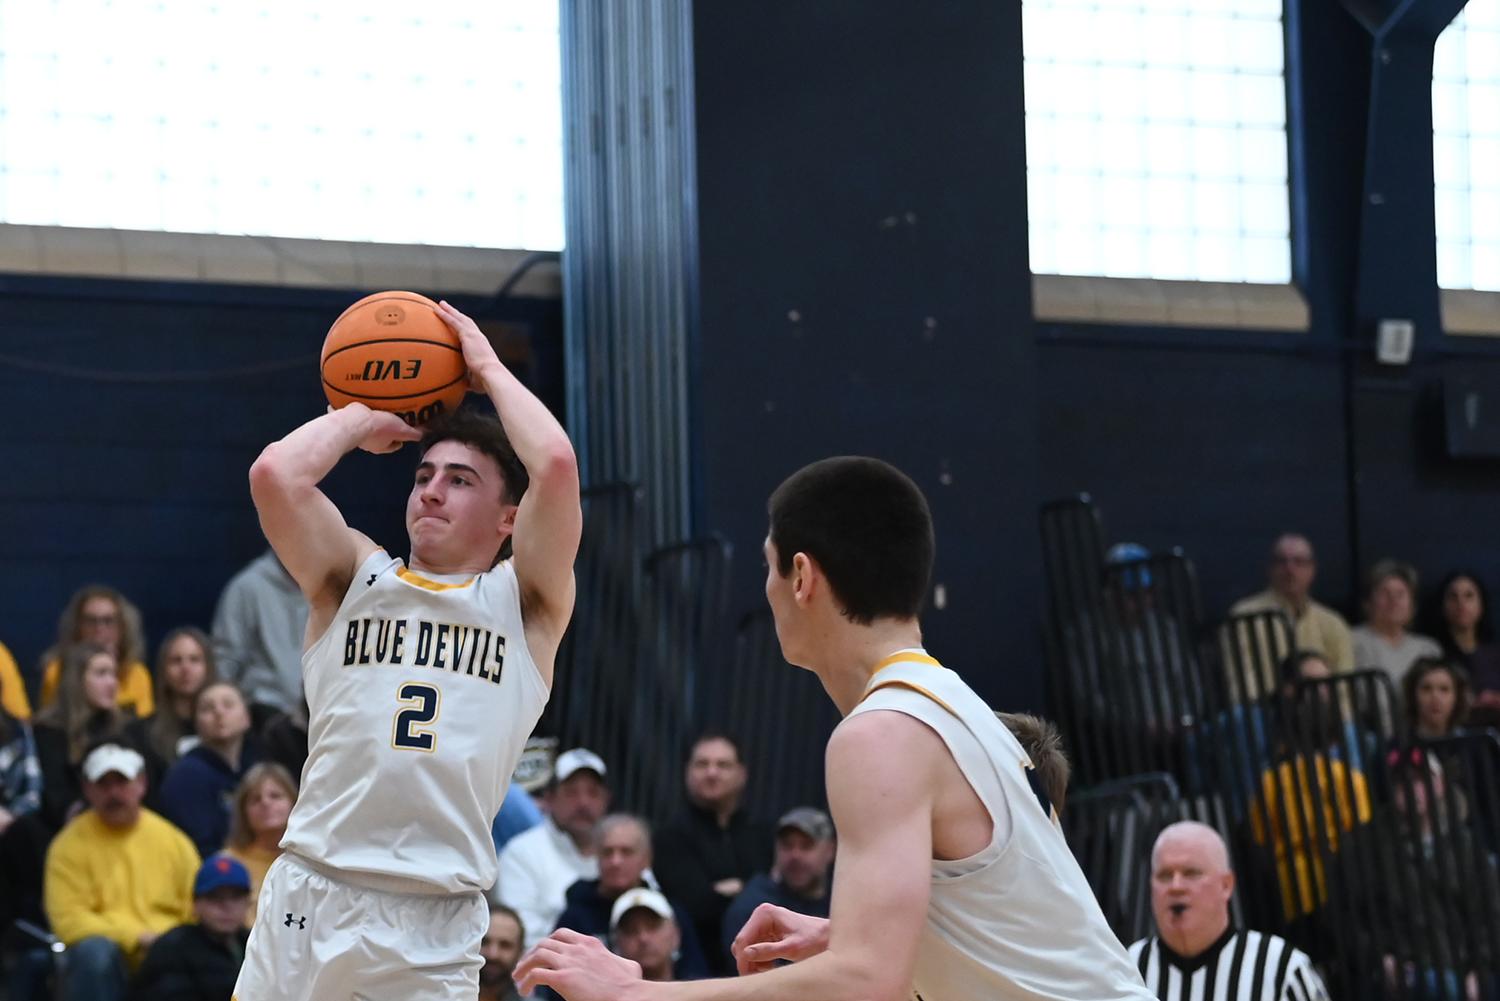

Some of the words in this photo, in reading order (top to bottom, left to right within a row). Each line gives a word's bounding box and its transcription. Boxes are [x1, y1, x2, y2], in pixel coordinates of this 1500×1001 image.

[362, 359, 422, 381] EVO
[342, 617, 408, 668] BLUE
[412, 618, 507, 686] DEVILS
[391, 681, 441, 753] 2
